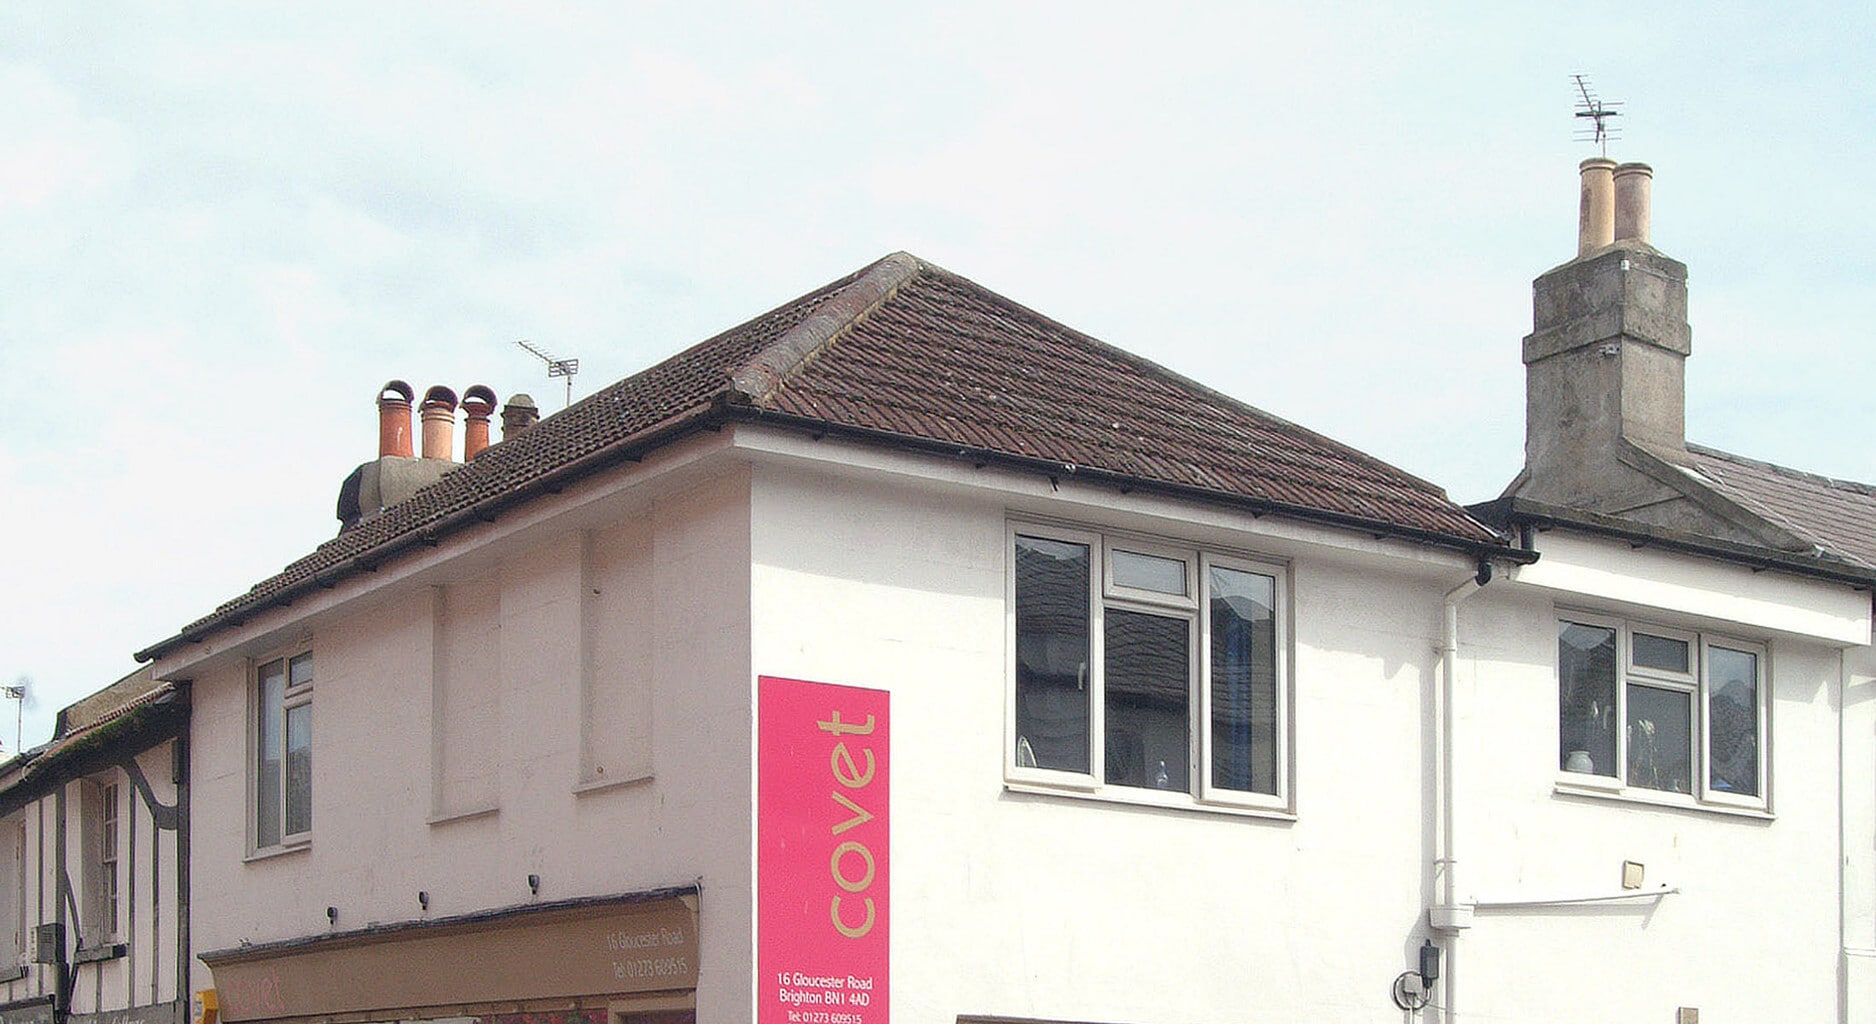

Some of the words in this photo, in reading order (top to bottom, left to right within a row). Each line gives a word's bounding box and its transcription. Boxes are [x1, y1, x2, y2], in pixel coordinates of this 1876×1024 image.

[817, 711, 875, 938] covet
[660, 927, 684, 945] Road
[778, 972, 791, 986] 16
[793, 972, 845, 989] Gloucester
[847, 975, 873, 990] Road
[779, 988, 822, 1006] Brighton
[825, 991, 845, 1005] BN1
[849, 993, 870, 1006] 4AD
[802, 1012, 829, 1024] 01273
[831, 1013, 862, 1024] 609515
